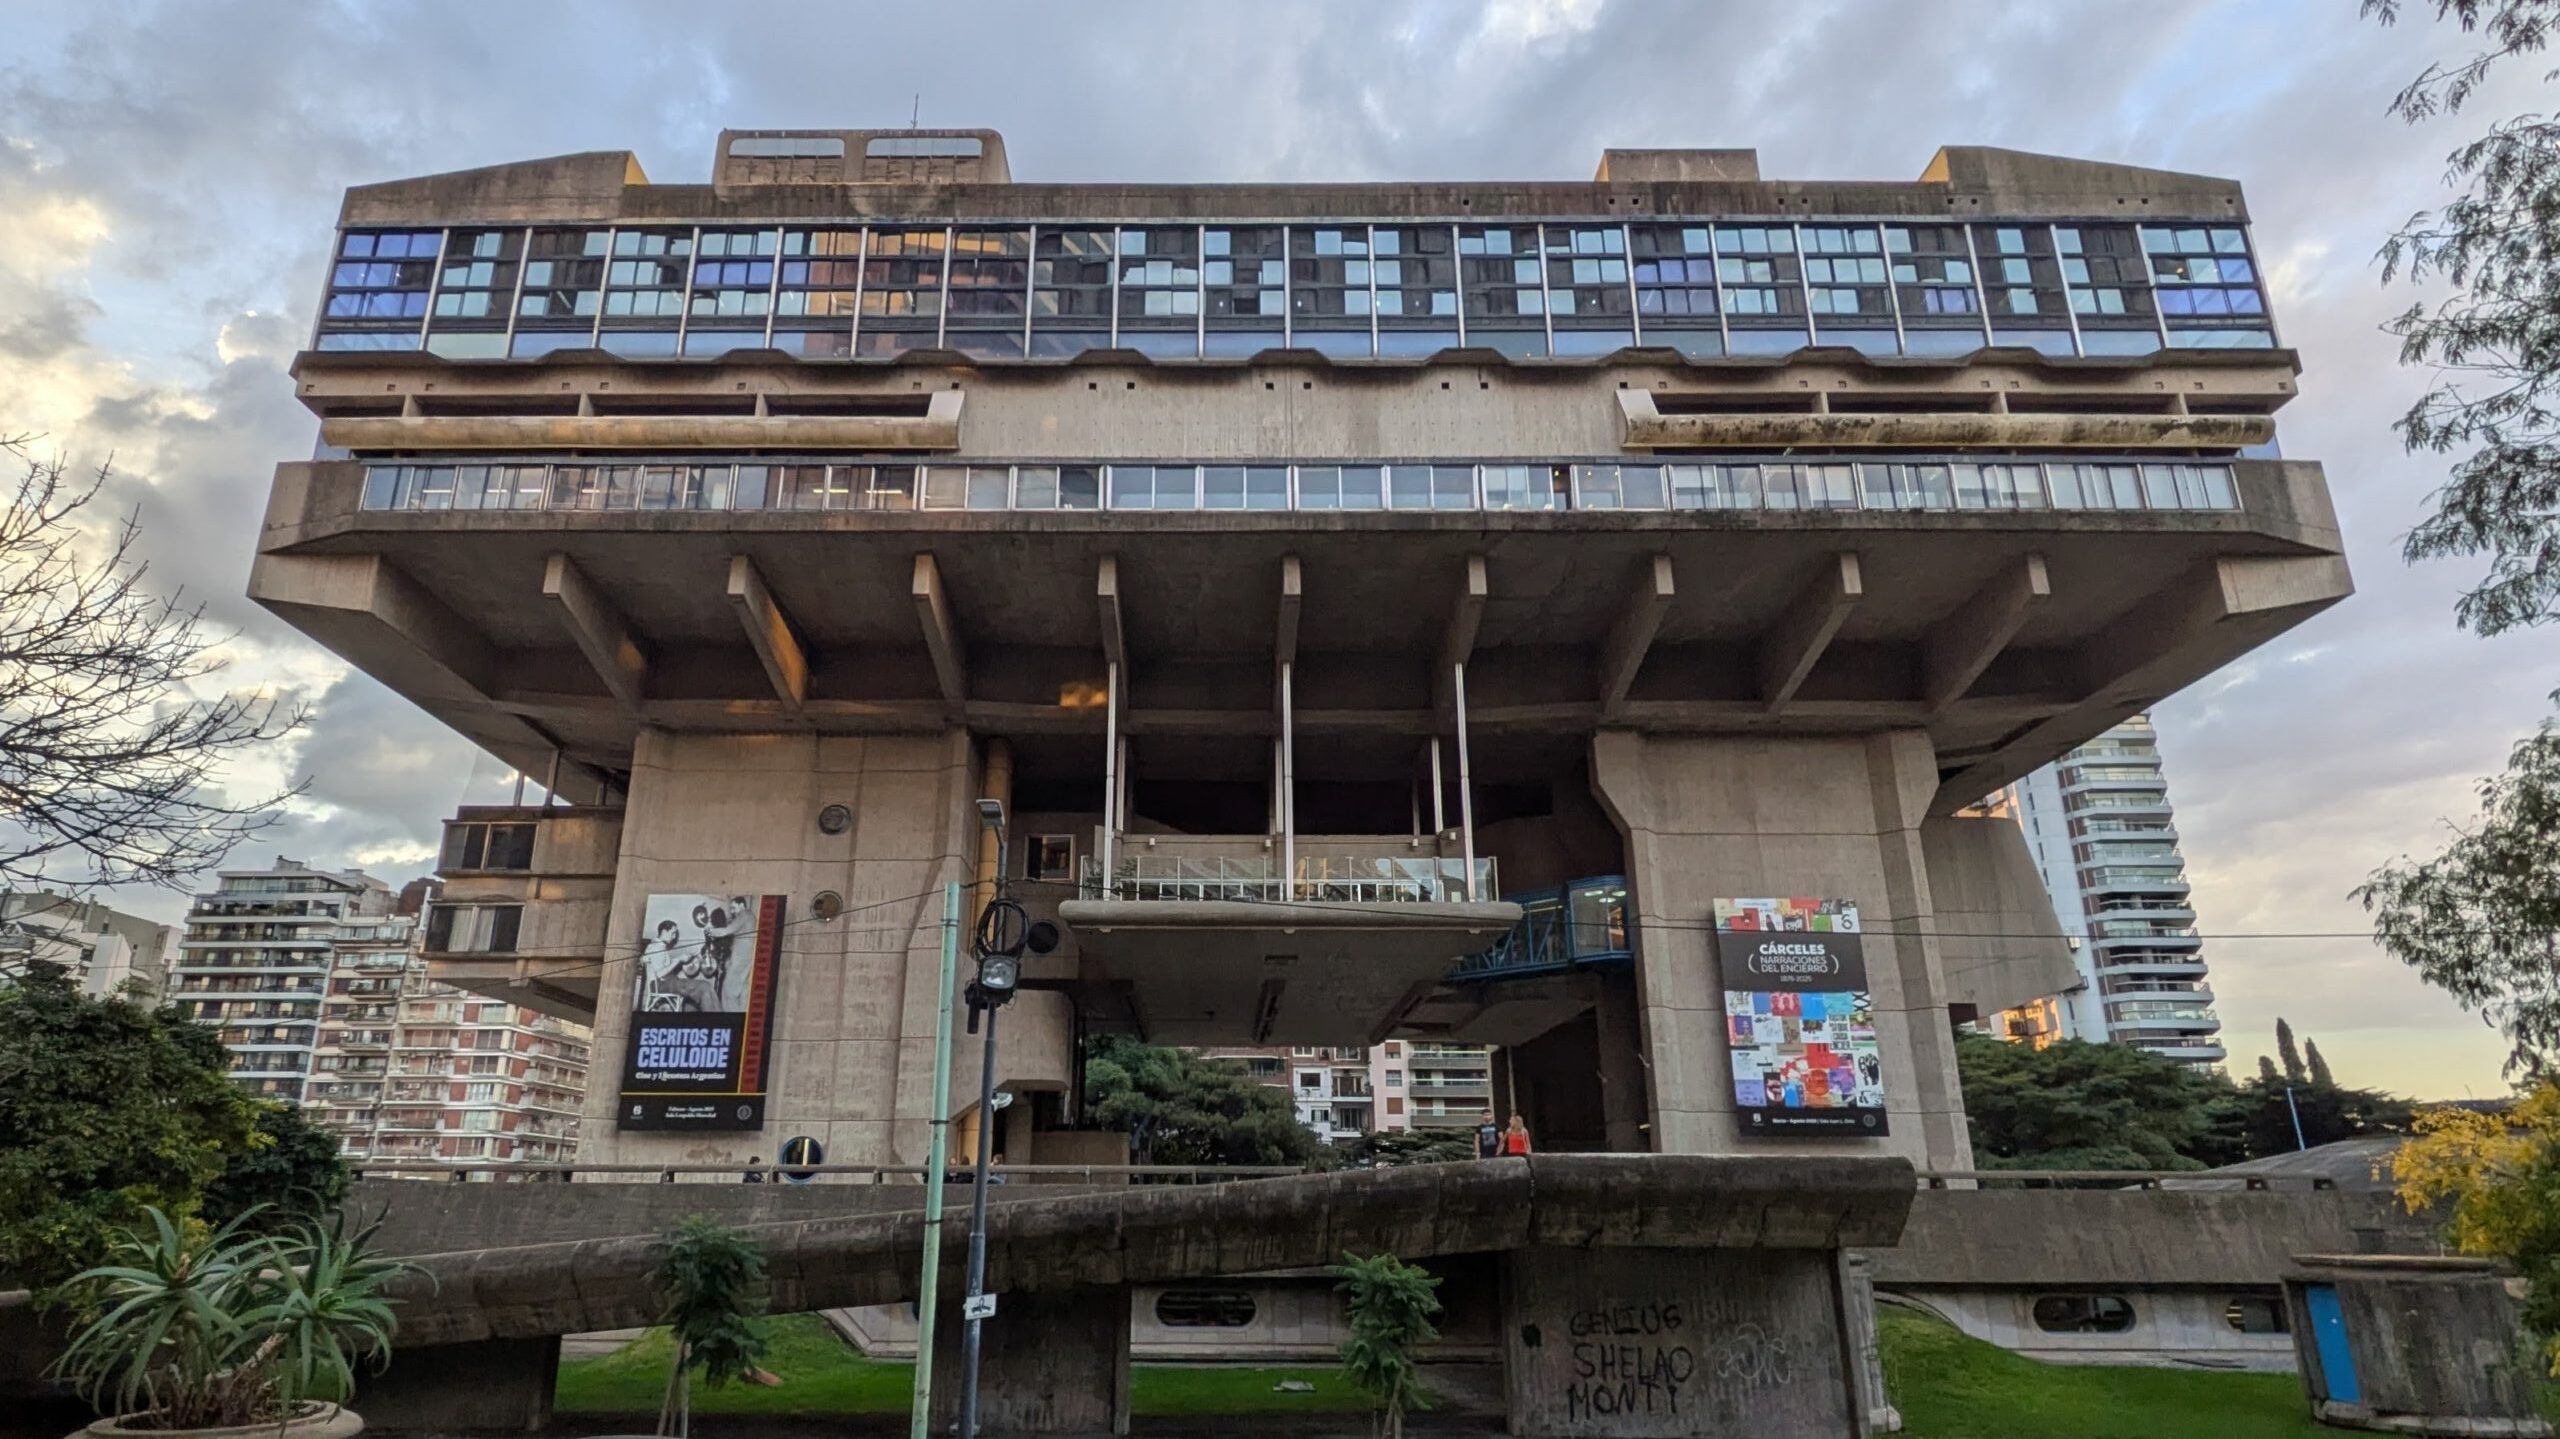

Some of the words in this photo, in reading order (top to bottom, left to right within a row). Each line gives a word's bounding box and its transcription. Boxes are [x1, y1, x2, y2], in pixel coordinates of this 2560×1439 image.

[1759, 940, 1825, 955] CÁRCELES
[1760, 956, 1827, 965] NARRACIONES
[1761, 964, 1779, 973] DEL
[1780, 964, 1828, 973] ENCIERRO
[640, 1028, 708, 1046] ESCRITOS
[711, 1028, 731, 1046] EN
[637, 1046, 729, 1068] CELULOIDE
[691, 1072, 726, 1081] Argentina
